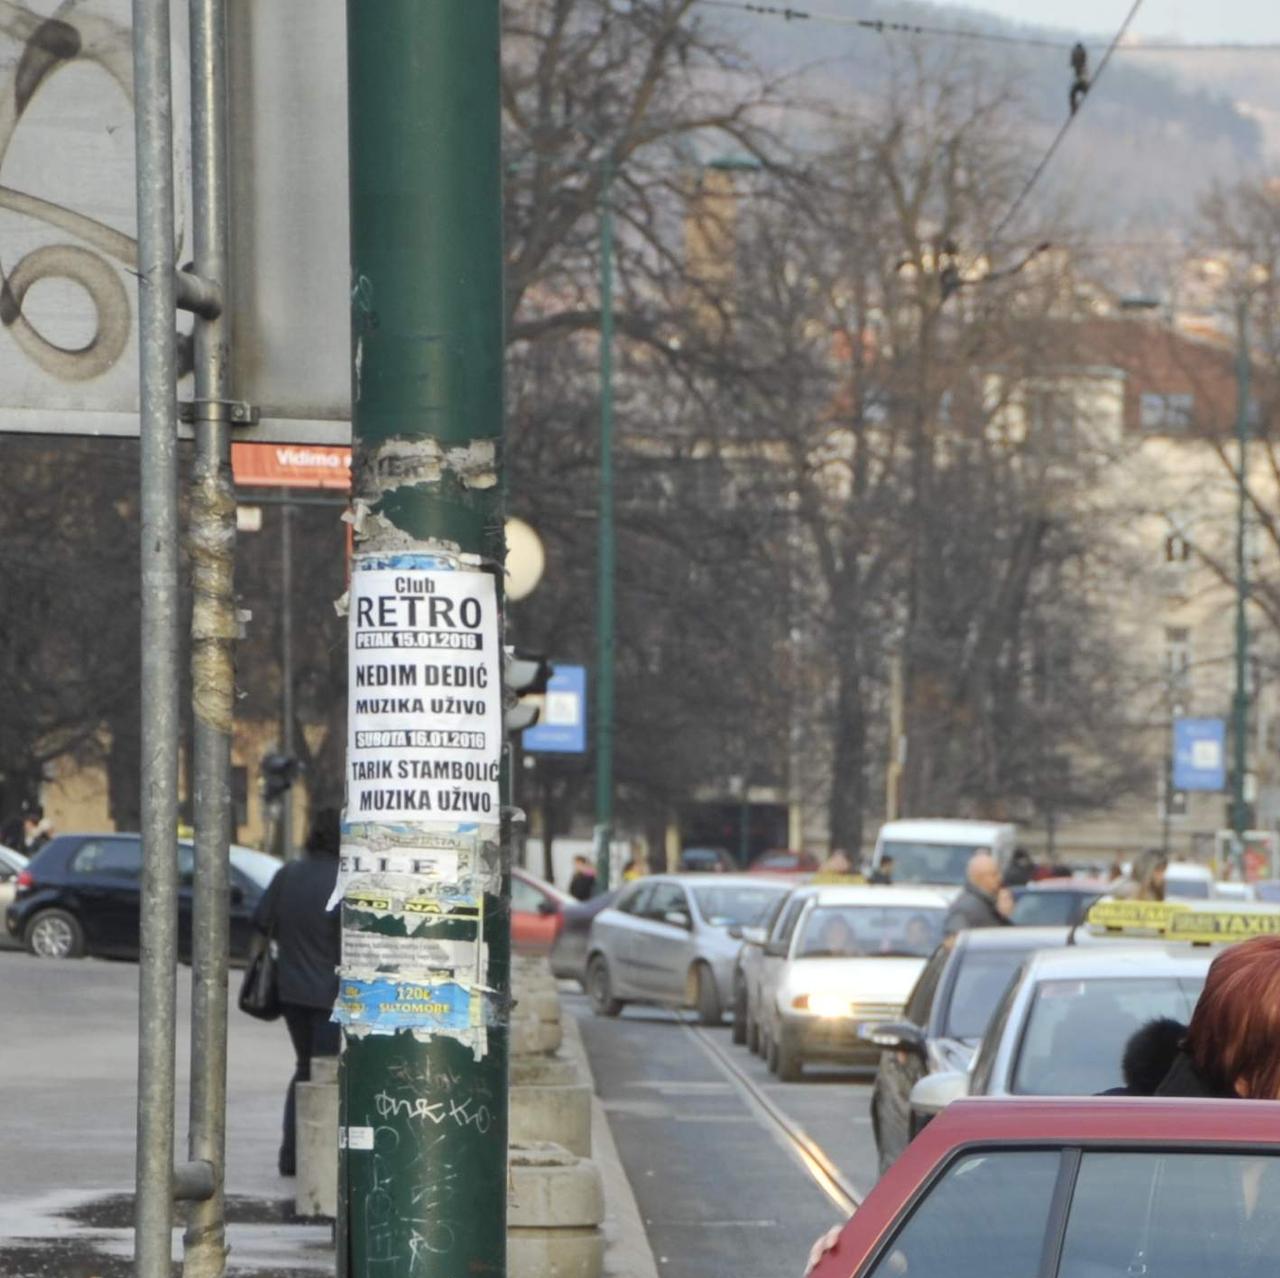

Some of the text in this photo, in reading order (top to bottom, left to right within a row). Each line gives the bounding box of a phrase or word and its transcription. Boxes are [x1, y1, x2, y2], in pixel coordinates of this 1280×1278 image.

[395, 576, 435, 594] Club
[357, 596, 482, 629] RETRO
[357, 632, 477, 649] PETAK 15.01.2016
[356, 662, 488, 688] NEDIM DEDIĆ
[355, 696, 487, 716] MUZIKA UŽIVO
[357, 731, 485, 749] SUBOTA 16.01.2016
[352, 759, 500, 782] TARIK STAMBOLIĆ
[359, 786, 492, 813] MUZIKA UŽIVO
